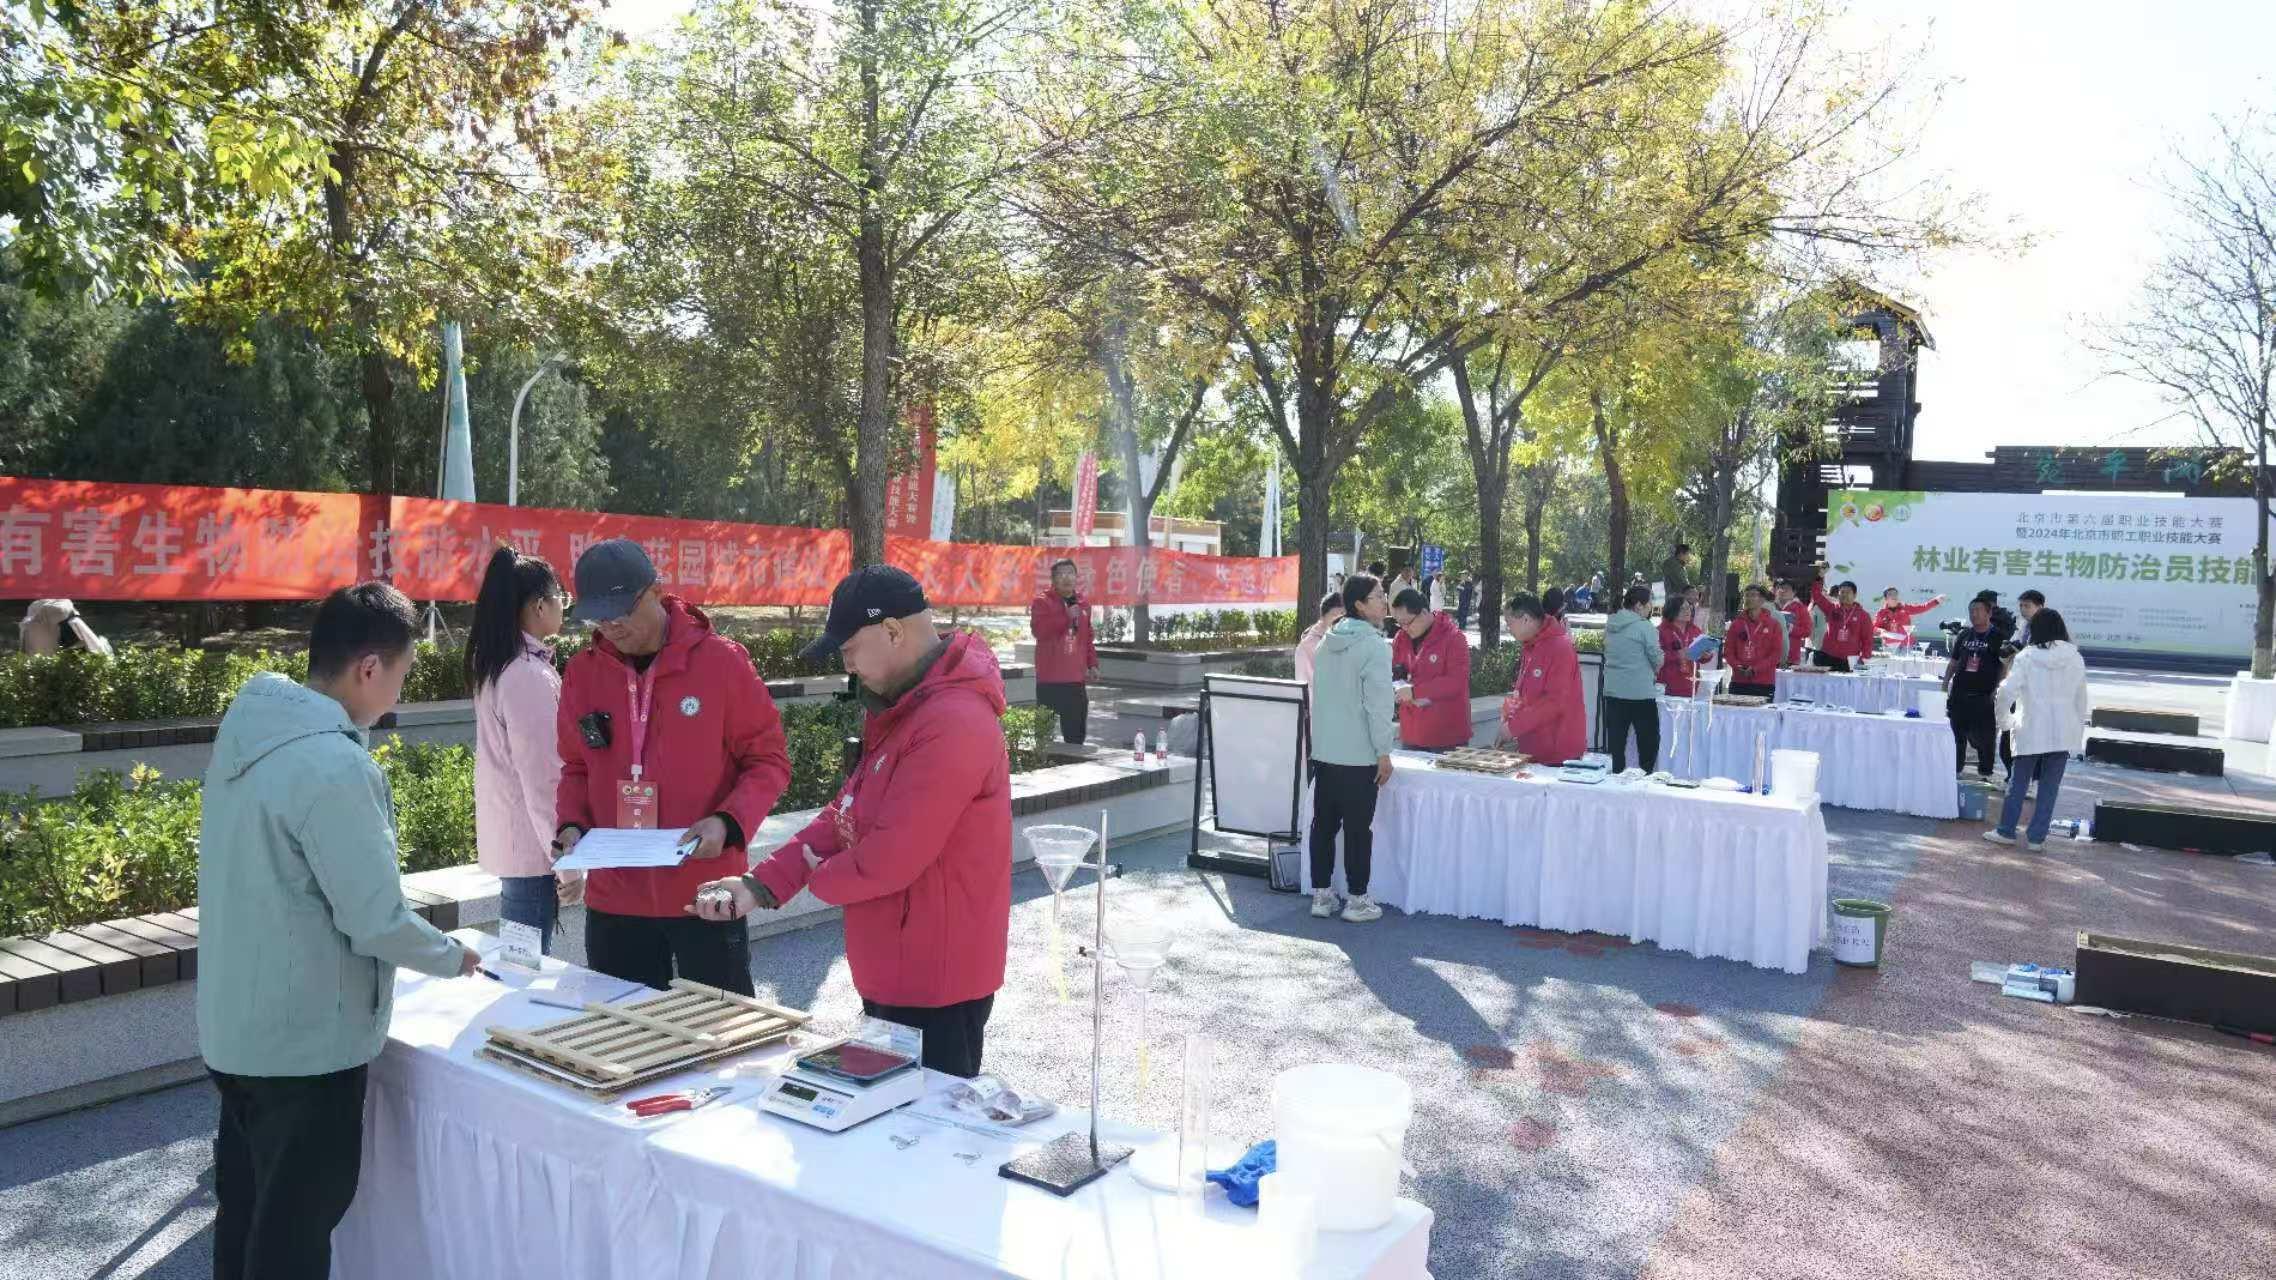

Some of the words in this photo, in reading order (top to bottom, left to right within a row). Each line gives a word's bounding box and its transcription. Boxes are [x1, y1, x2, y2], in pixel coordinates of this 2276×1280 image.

[2016, 511, 2224, 529] 北京市第六届职业技能大赛
[2015, 527, 2223, 545] 暨2024年北京市职工职业技能大赛
[1912, 545, 2258, 585] 林业有害生物防治员技能
